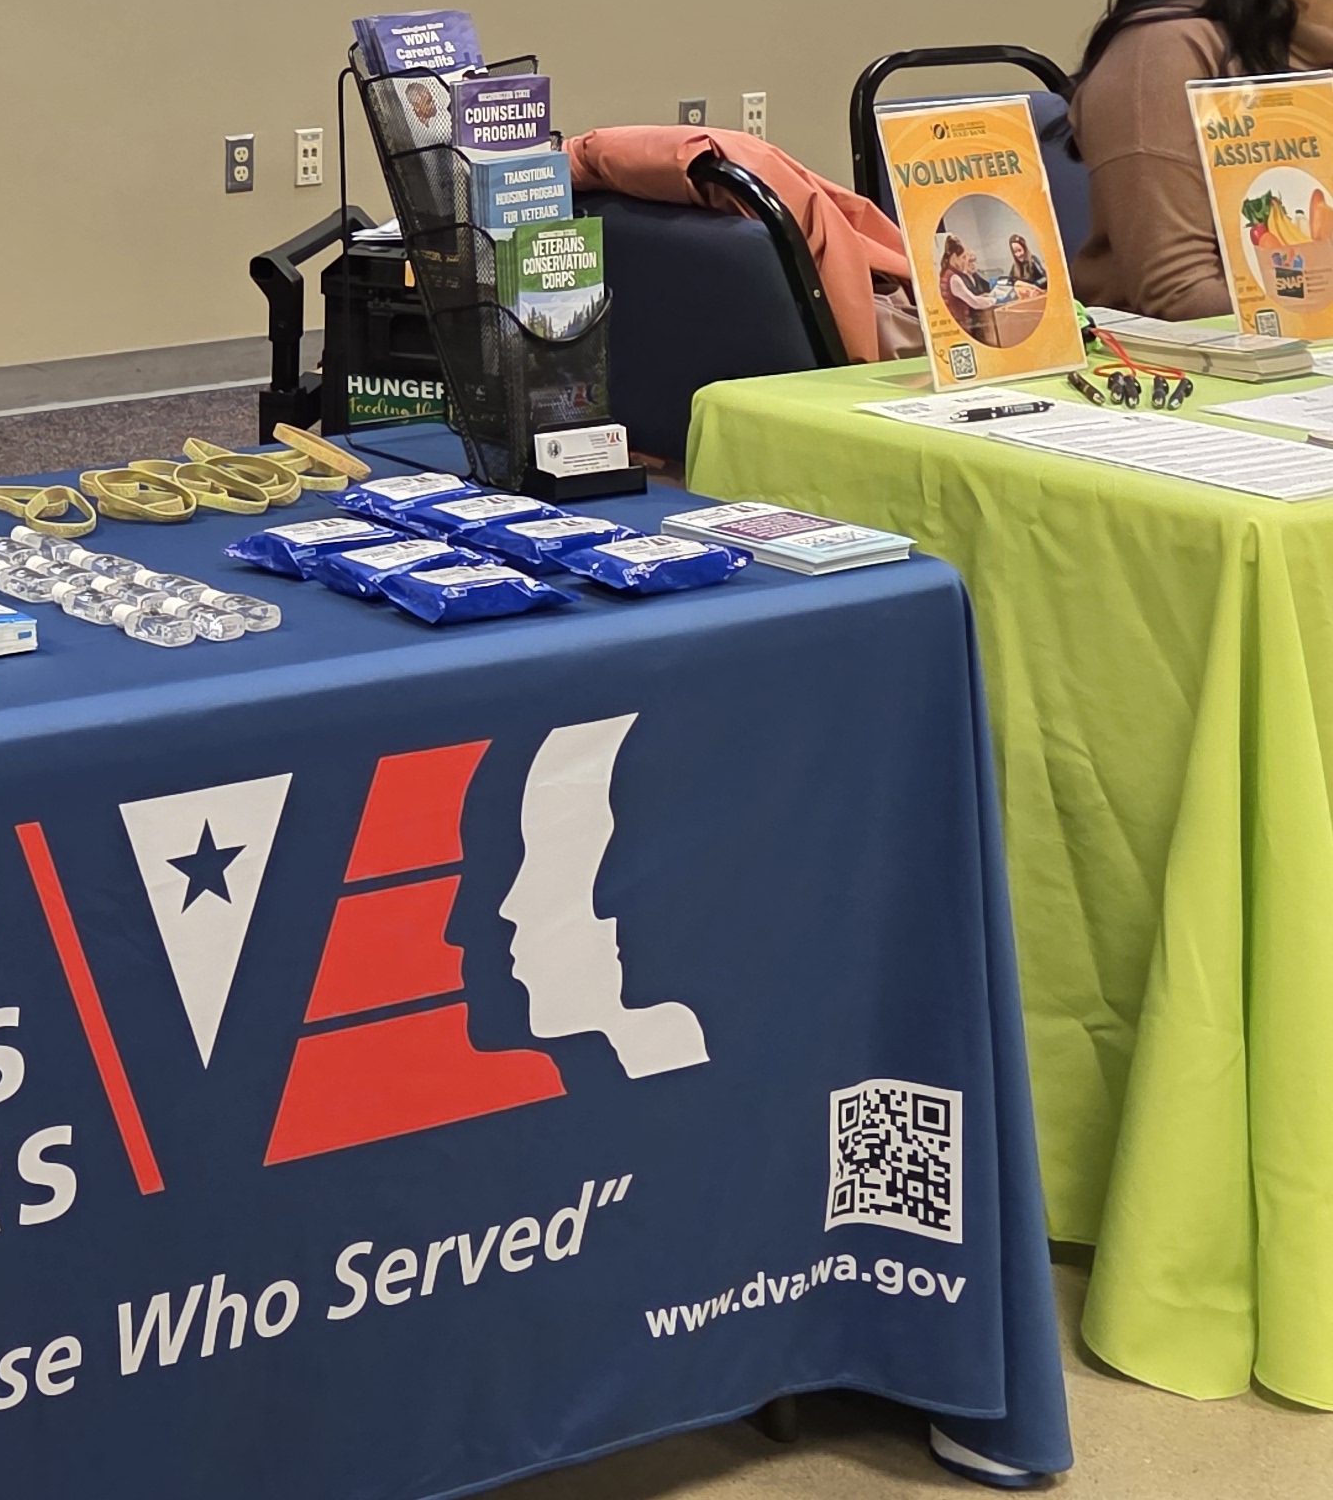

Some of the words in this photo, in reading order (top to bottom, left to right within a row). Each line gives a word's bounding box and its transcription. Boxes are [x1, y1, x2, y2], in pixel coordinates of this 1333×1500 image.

[402, 31, 440, 47] WDVA
[396, 45, 443, 60] Careers
[445, 41, 456, 54] &
[465, 102, 545, 124] COUNSELING
[473, 122, 537, 143] PROGRAM
[1207, 115, 1255, 140] SNAP
[1214, 136, 1320, 167] ASSISTANCE
[504, 166, 555, 185] TRANSITIONAL
[895, 150, 1023, 188] VOLUNTEER
[496, 189, 528, 206] HOUSING
[530, 185, 564, 201] PROGRAM
[503, 211, 518, 224] FOR
[521, 205, 559, 222] VETERANS
[532, 236, 585, 257] VETERANS
[523, 251, 597, 276] CONSERVATION
[541, 271, 576, 290] CORPS
[117, 1273, 302, 1379] Who
[326, 1173, 634, 1322] Served"
[645, 1254, 966, 1338] www.dva.wa.gov
